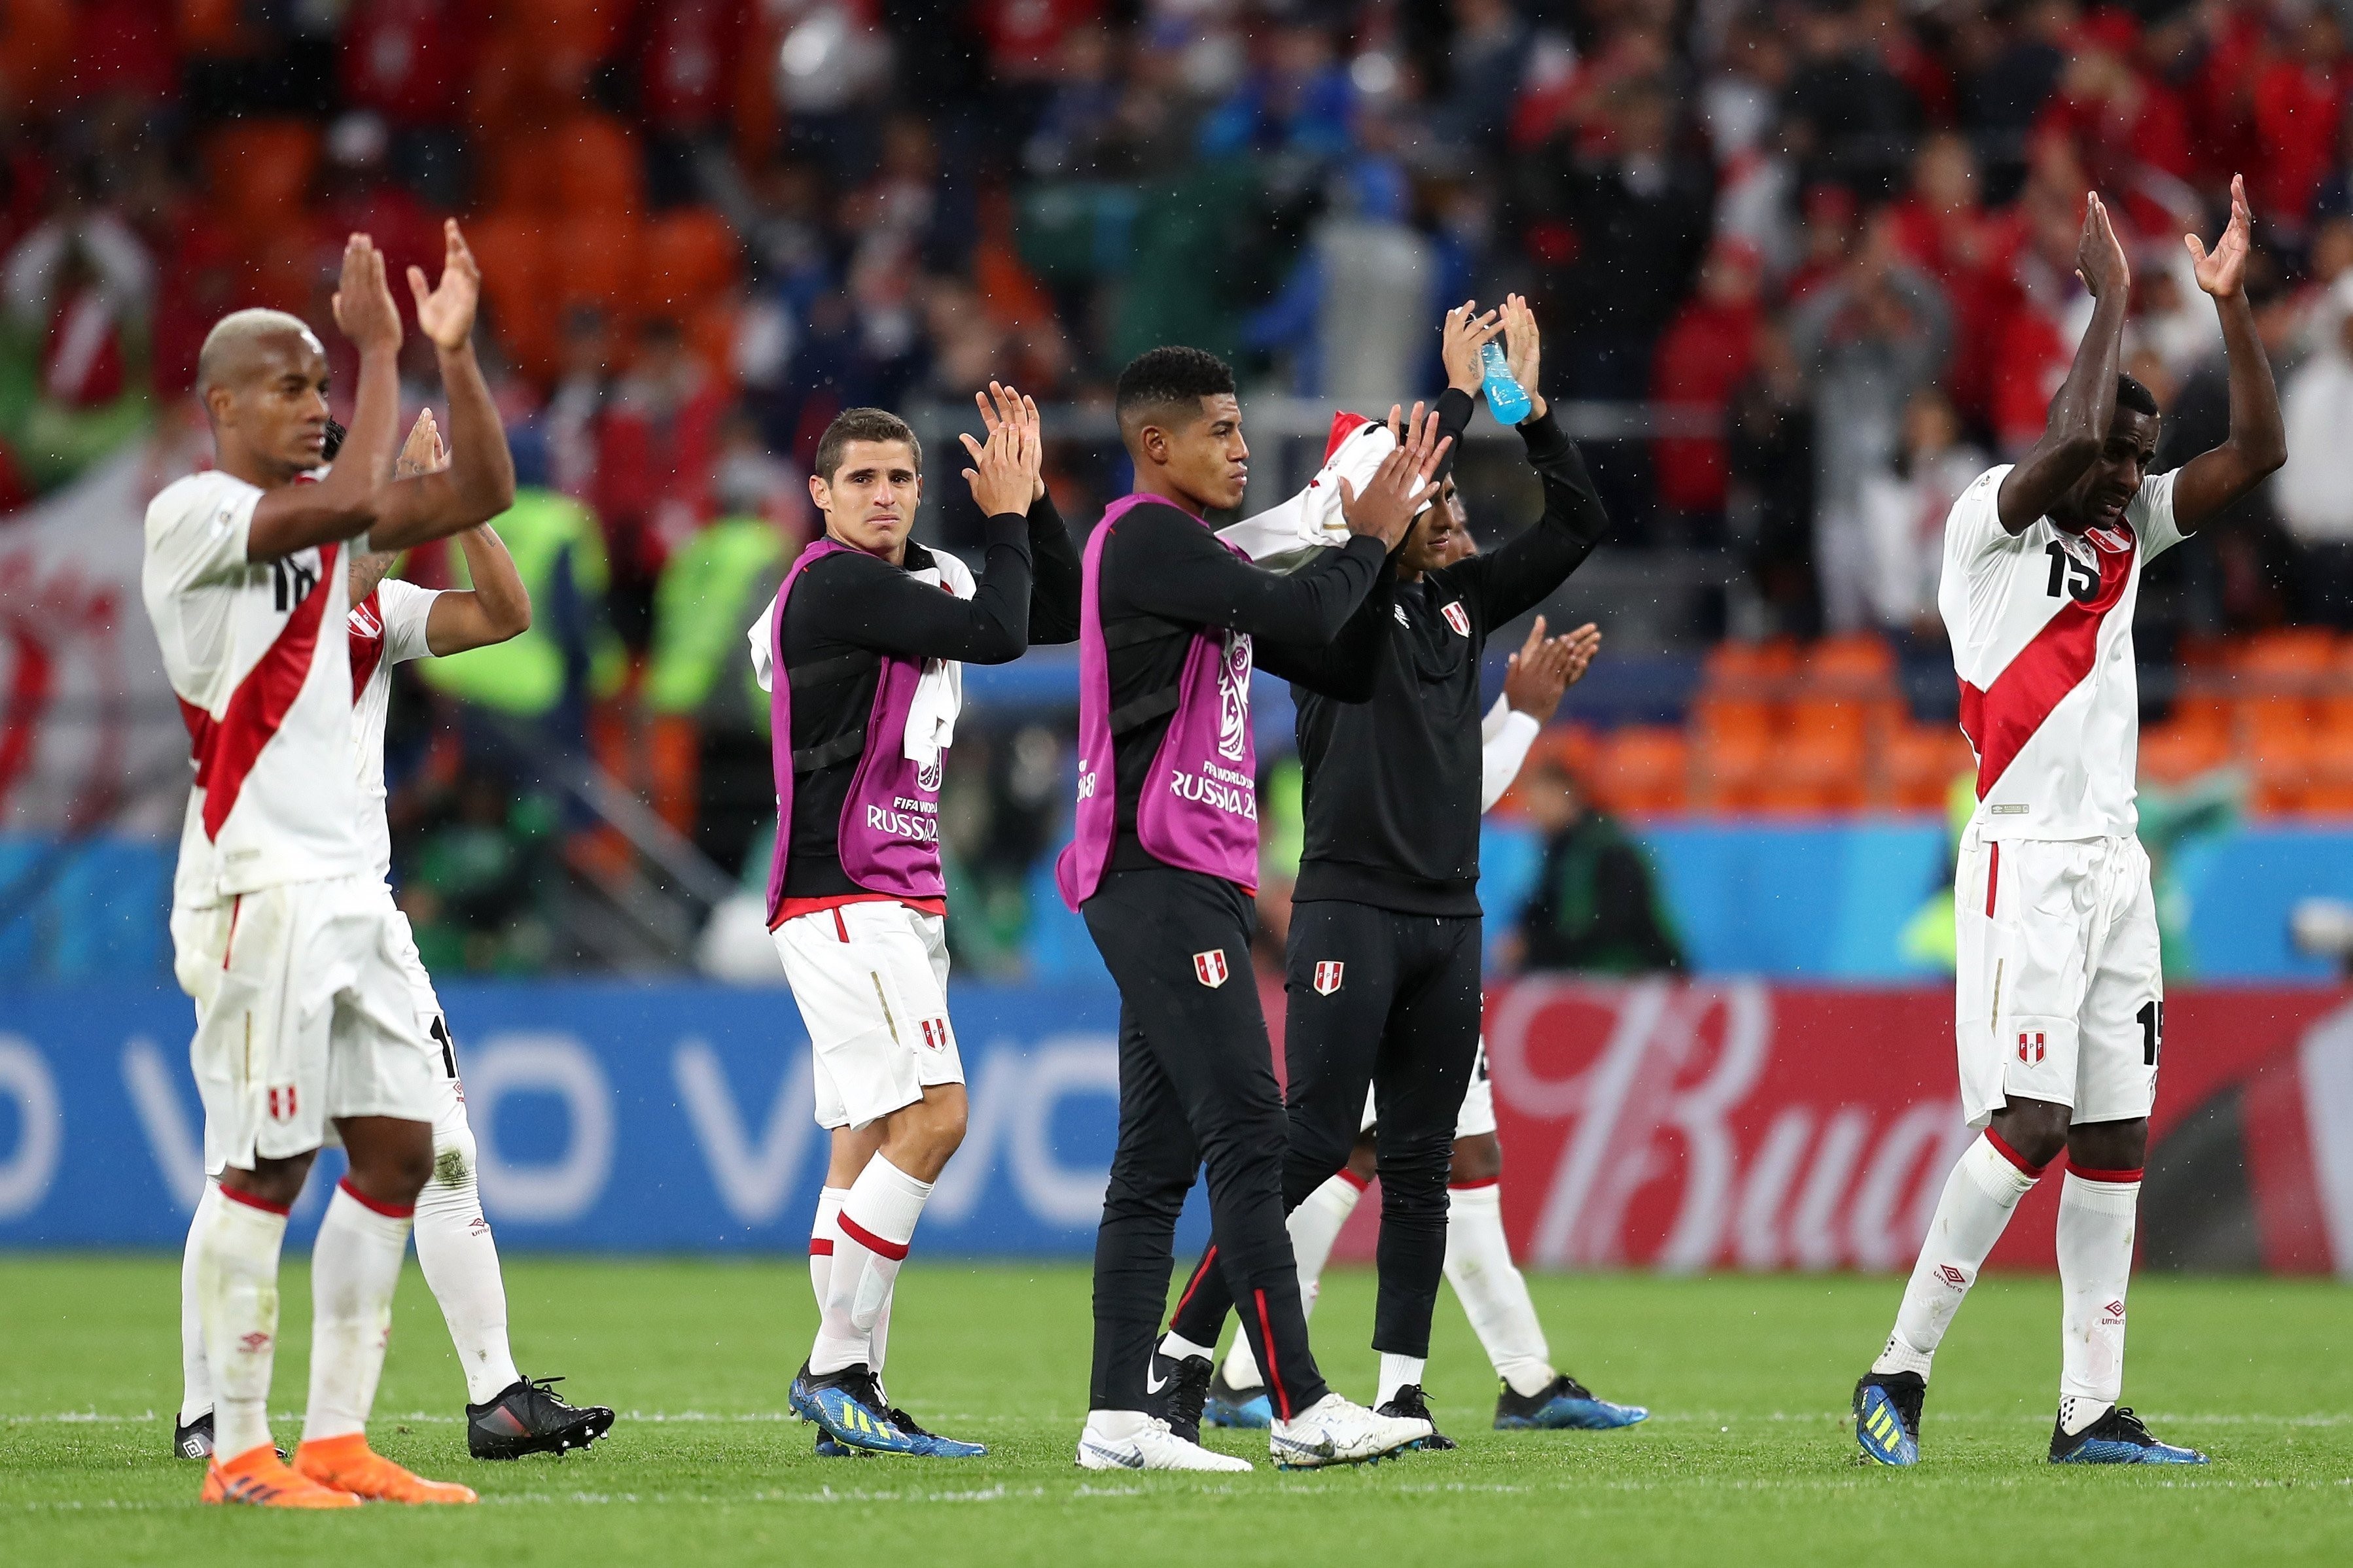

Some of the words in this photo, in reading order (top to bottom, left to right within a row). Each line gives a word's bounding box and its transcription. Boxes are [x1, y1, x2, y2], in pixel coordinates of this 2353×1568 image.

[2098, 527, 2120, 546] FPF
[2045, 540, 2101, 603] 15
[1169, 769, 1243, 816] RUSSIA
[893, 796, 919, 812] FIFA
[1200, 960, 1223, 973] FPF
[1318, 971, 1339, 980] FPF
[926, 1028, 944, 1038] FPF
[429, 1015, 460, 1078] 1
[2021, 1042, 2043, 1051] FPF
[1933, 1270, 1963, 1293] umbro
